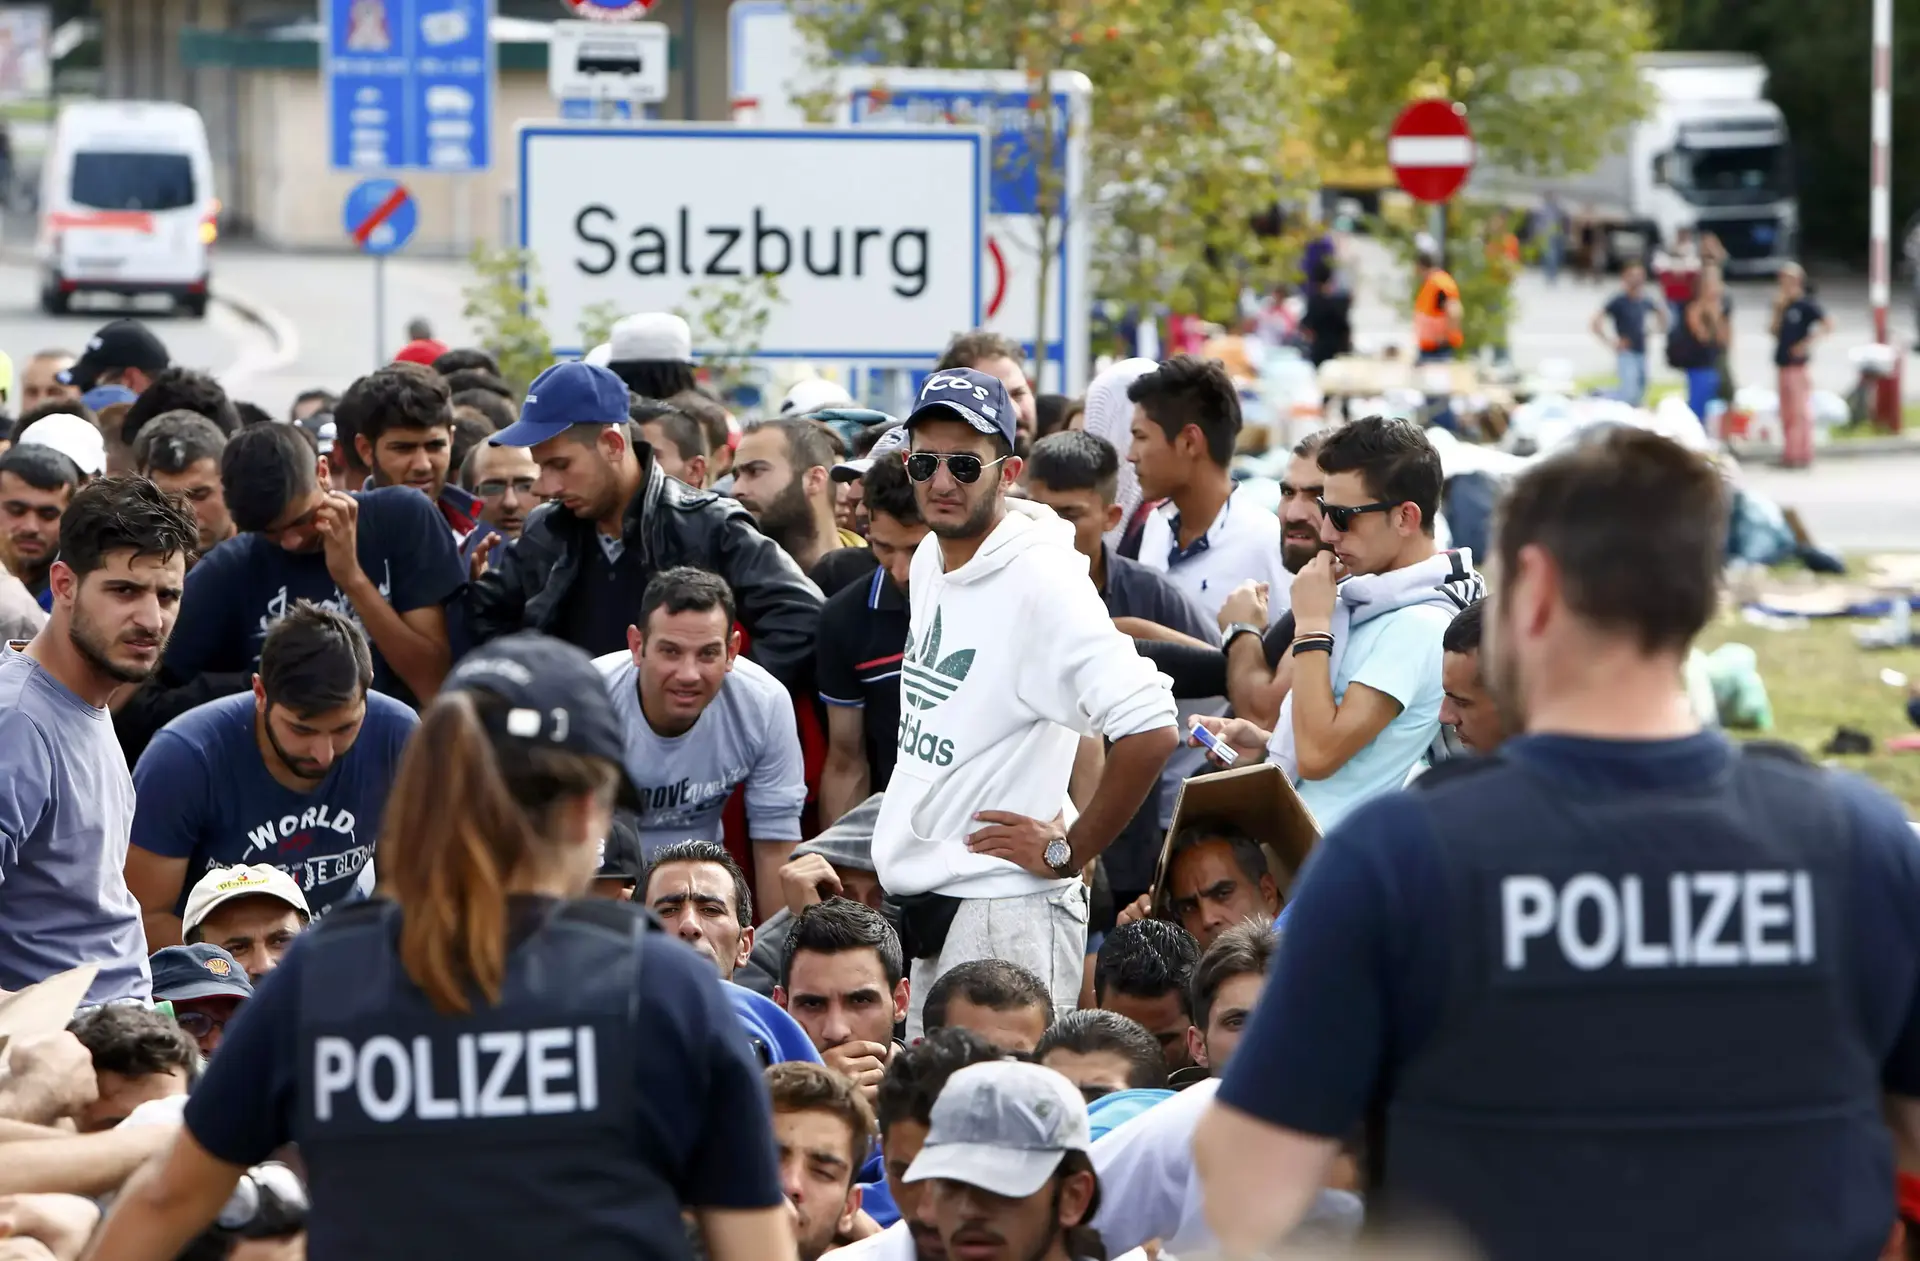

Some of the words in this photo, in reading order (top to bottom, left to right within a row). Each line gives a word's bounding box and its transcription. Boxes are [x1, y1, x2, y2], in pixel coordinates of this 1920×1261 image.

[574, 203, 930, 299] Salzburg
[897, 712, 955, 767] didas
[247, 804, 356, 851] WORLD
[1501, 869, 1816, 971] POLIZEI
[313, 1025, 599, 1123] POLIZEI
